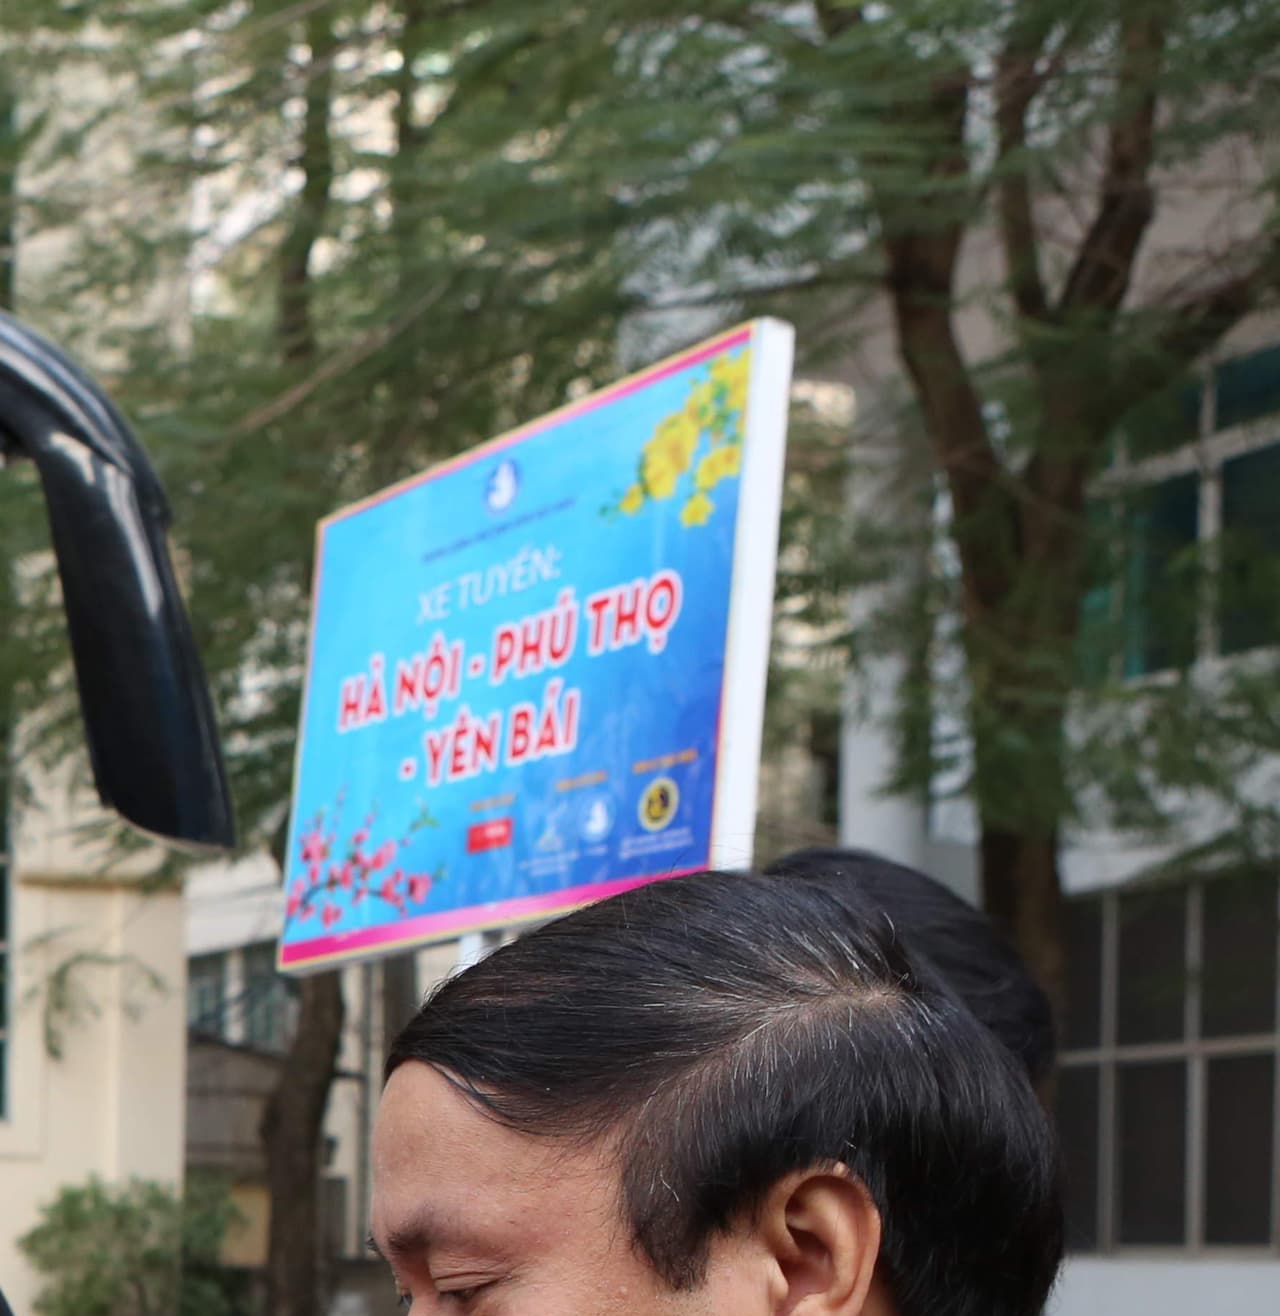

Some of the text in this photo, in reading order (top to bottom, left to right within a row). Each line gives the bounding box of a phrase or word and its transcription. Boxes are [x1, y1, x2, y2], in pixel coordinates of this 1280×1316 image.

[339, 654, 387, 732] HÀ
[394, 633, 464, 719] NỘI
[493, 588, 577, 683] PHÚ
[588, 570, 681, 655] THỌ
[416, 582, 452, 625] XE
[424, 705, 501, 785] YÊN
[507, 678, 580, 765] BÁI
